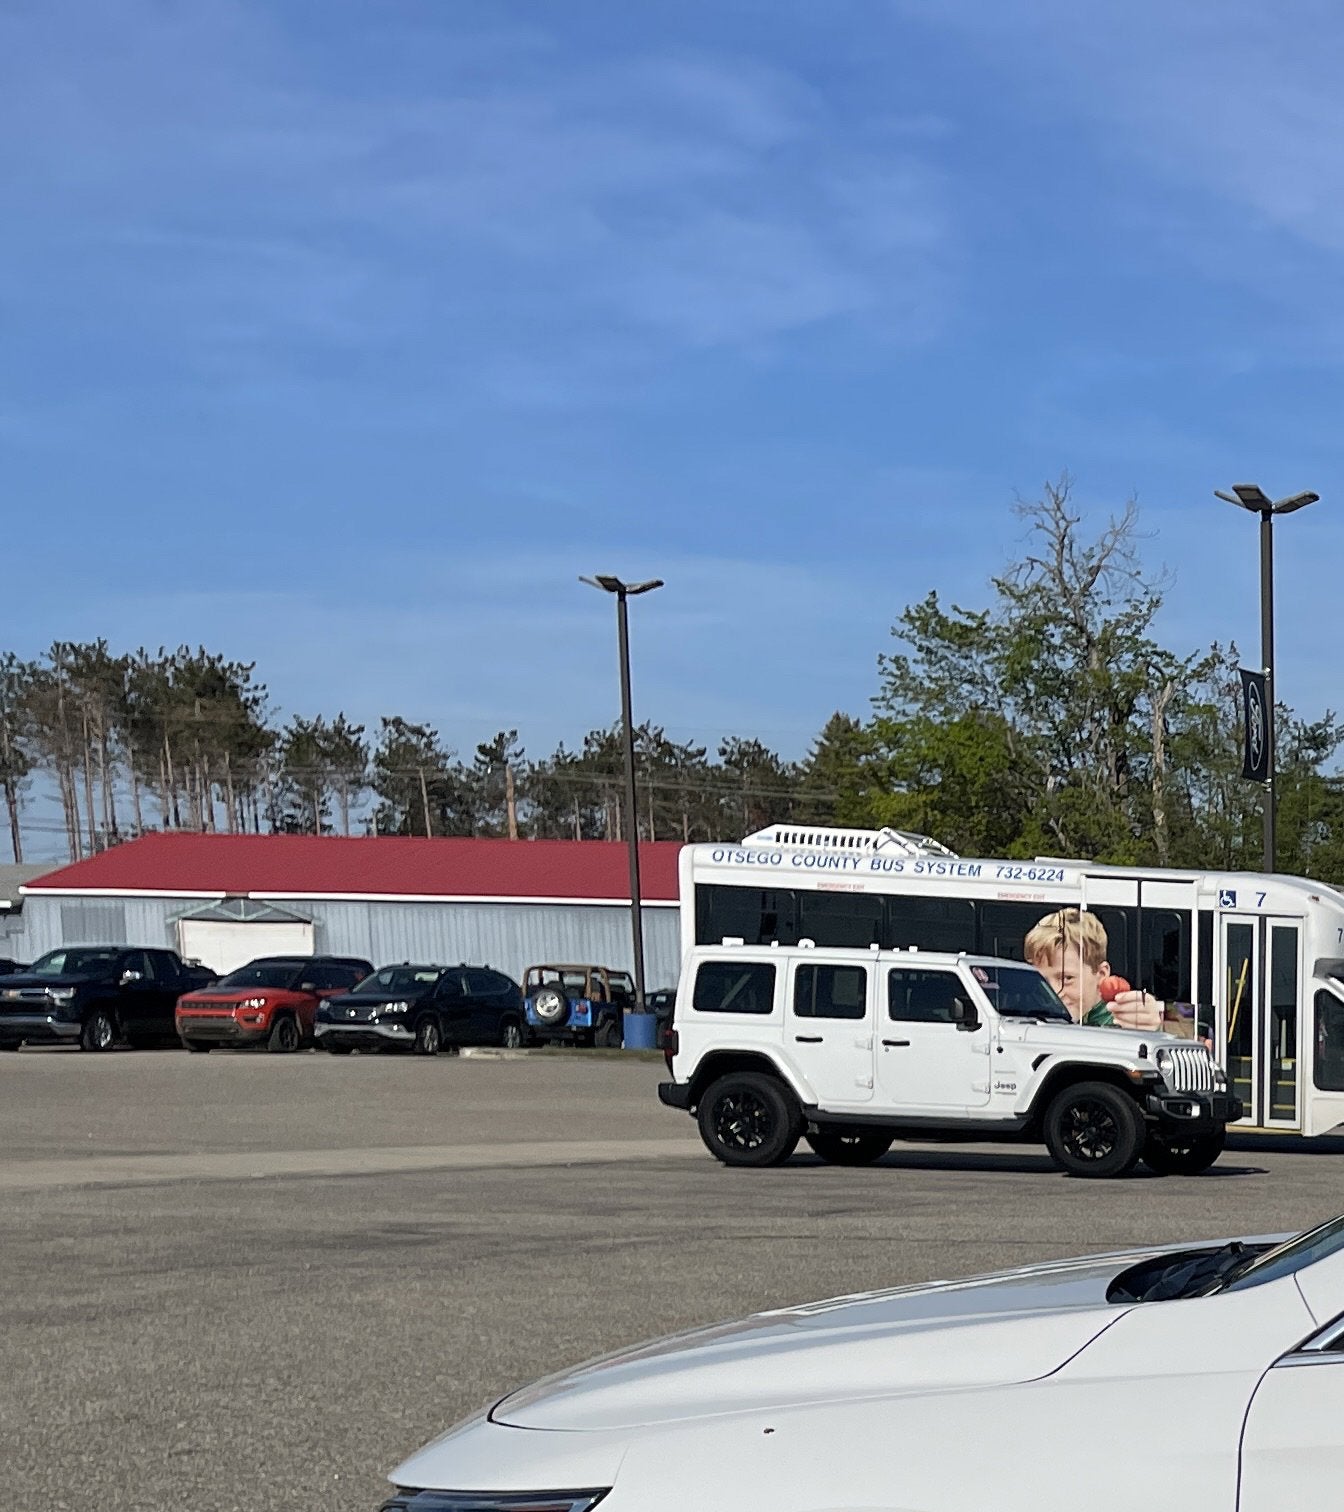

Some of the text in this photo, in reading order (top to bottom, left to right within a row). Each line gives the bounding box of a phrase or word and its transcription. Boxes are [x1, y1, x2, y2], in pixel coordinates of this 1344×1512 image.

[1249, 697, 1262, 755] Ford
[711, 849, 1065, 882] OTSEGO COUNTY BUS SYSTEM 732-6224
[1255, 891, 1267, 907] 7
[1337, 927, 1344, 944] 7
[994, 1080, 1017, 1091] Jeep
